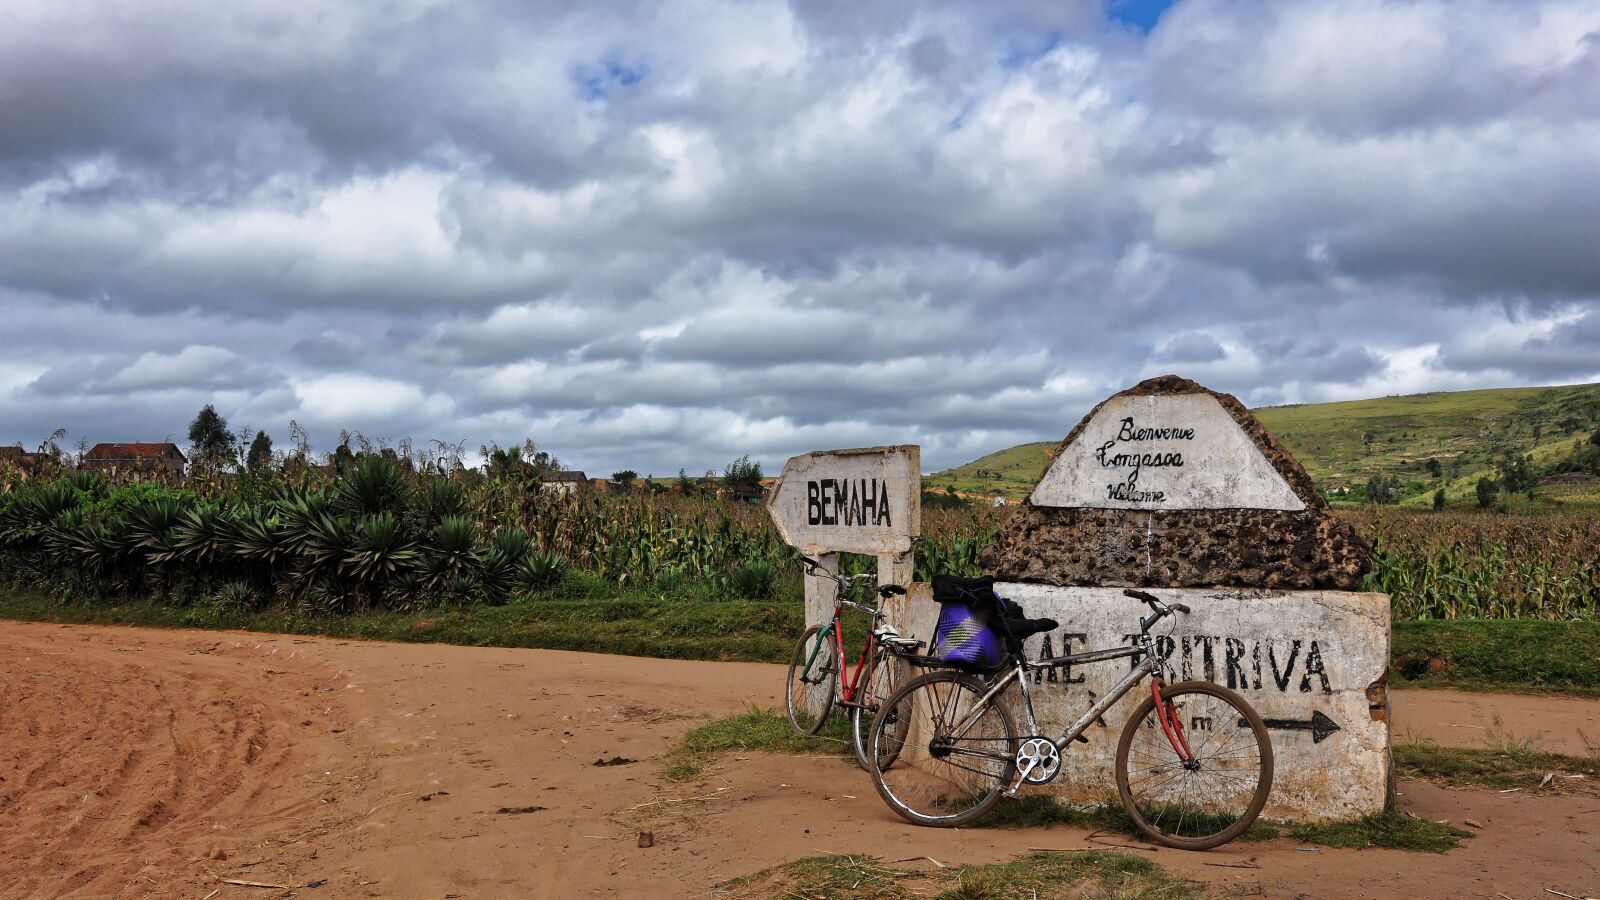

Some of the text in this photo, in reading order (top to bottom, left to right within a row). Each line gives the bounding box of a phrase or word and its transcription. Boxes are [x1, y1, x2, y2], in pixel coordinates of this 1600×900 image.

[1117, 416, 1195, 442] Bienvenue
[807, 478, 892, 527] BEMAHA
[1122, 634, 1332, 695] TRITRIVA
